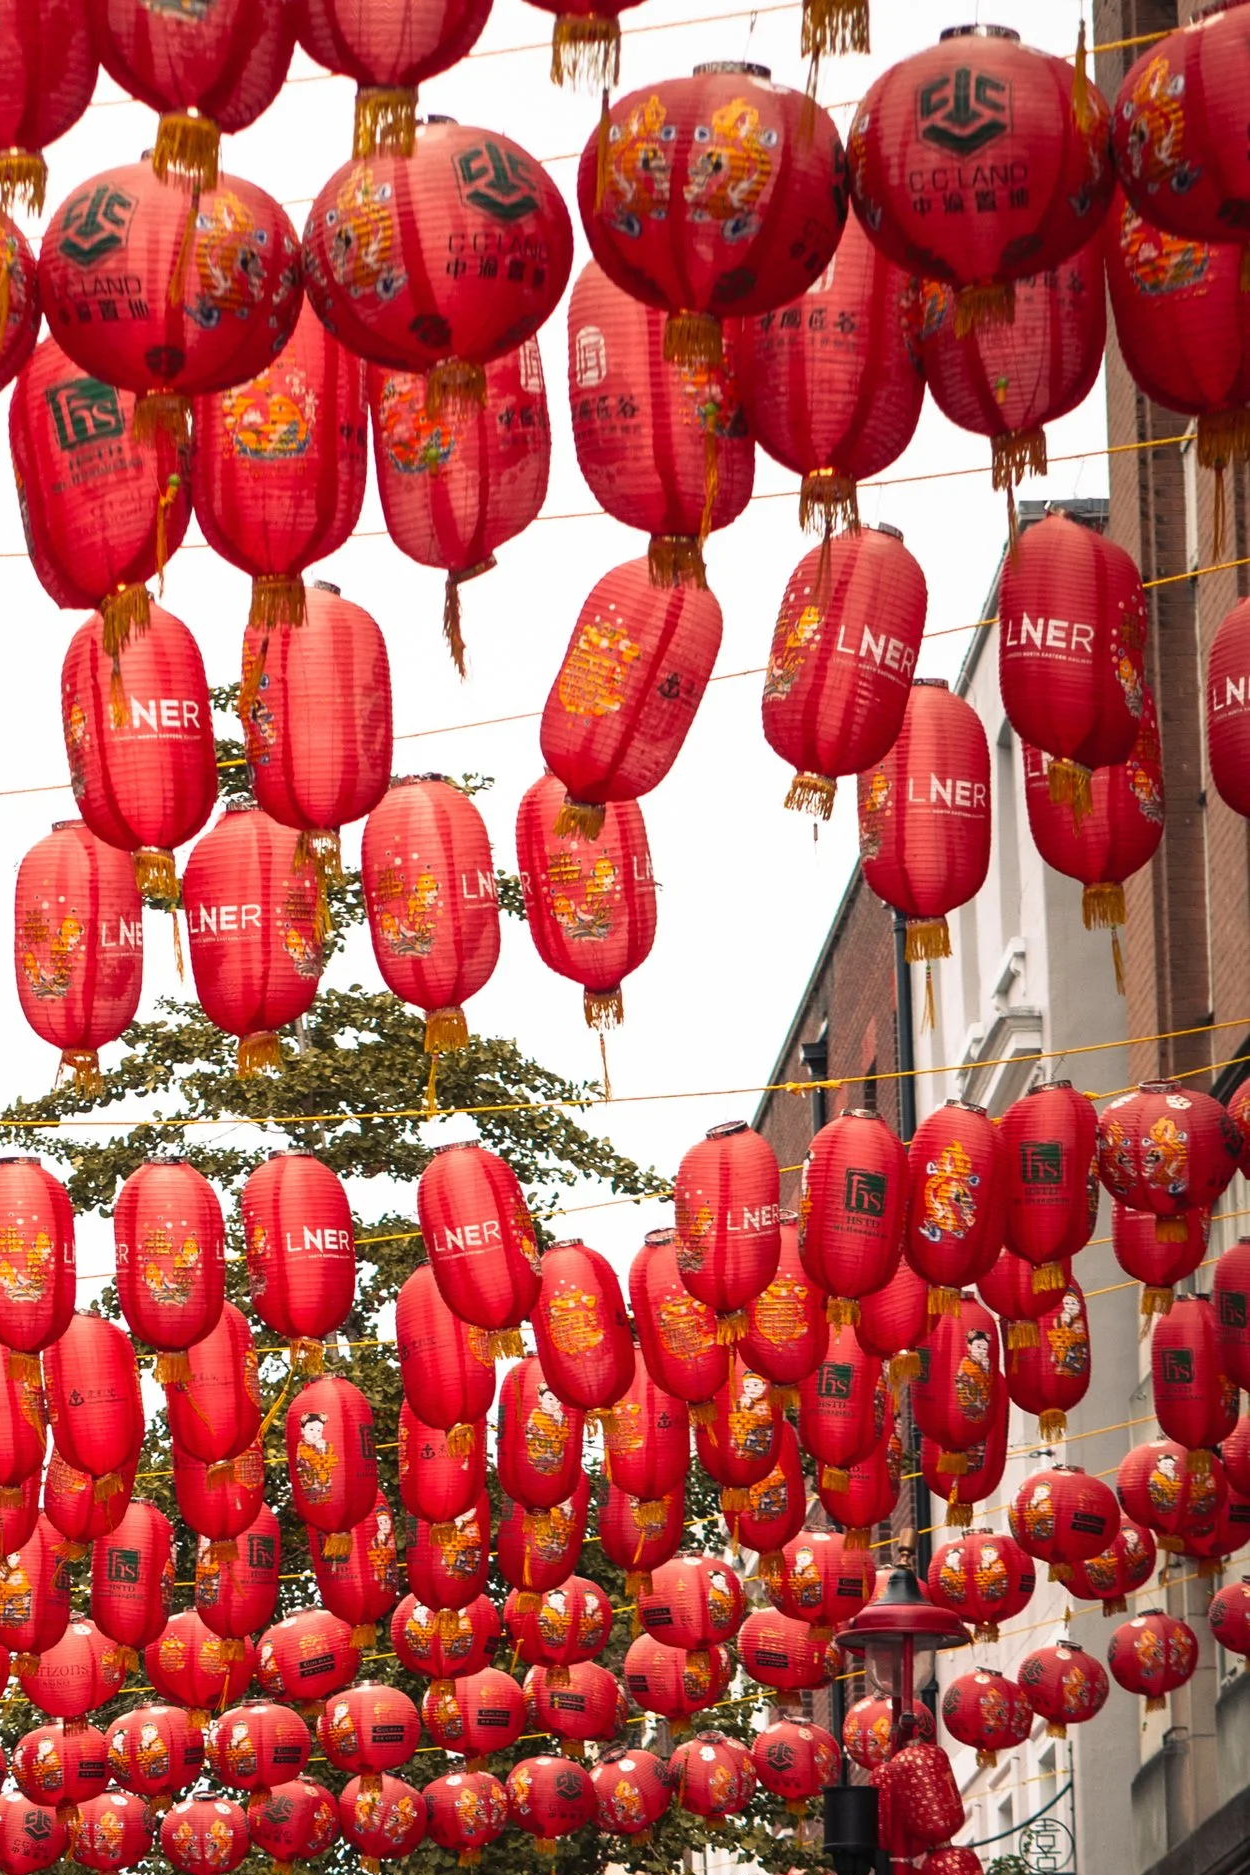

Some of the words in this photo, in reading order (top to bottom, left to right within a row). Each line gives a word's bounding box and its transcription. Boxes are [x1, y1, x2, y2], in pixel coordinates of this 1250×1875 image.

[837, 622, 914, 676] LNER
[1007, 612, 1094, 653] LNER
[1213, 672, 1250, 706] LN
[910, 773, 986, 808] LNER
[190, 896, 261, 936] LNER
[287, 1225, 351, 1252] LNER
[435, 1219, 502, 1254] LNER
[846, 1215, 879, 1227] HSTD
[38, 1662, 89, 1678] rizons
